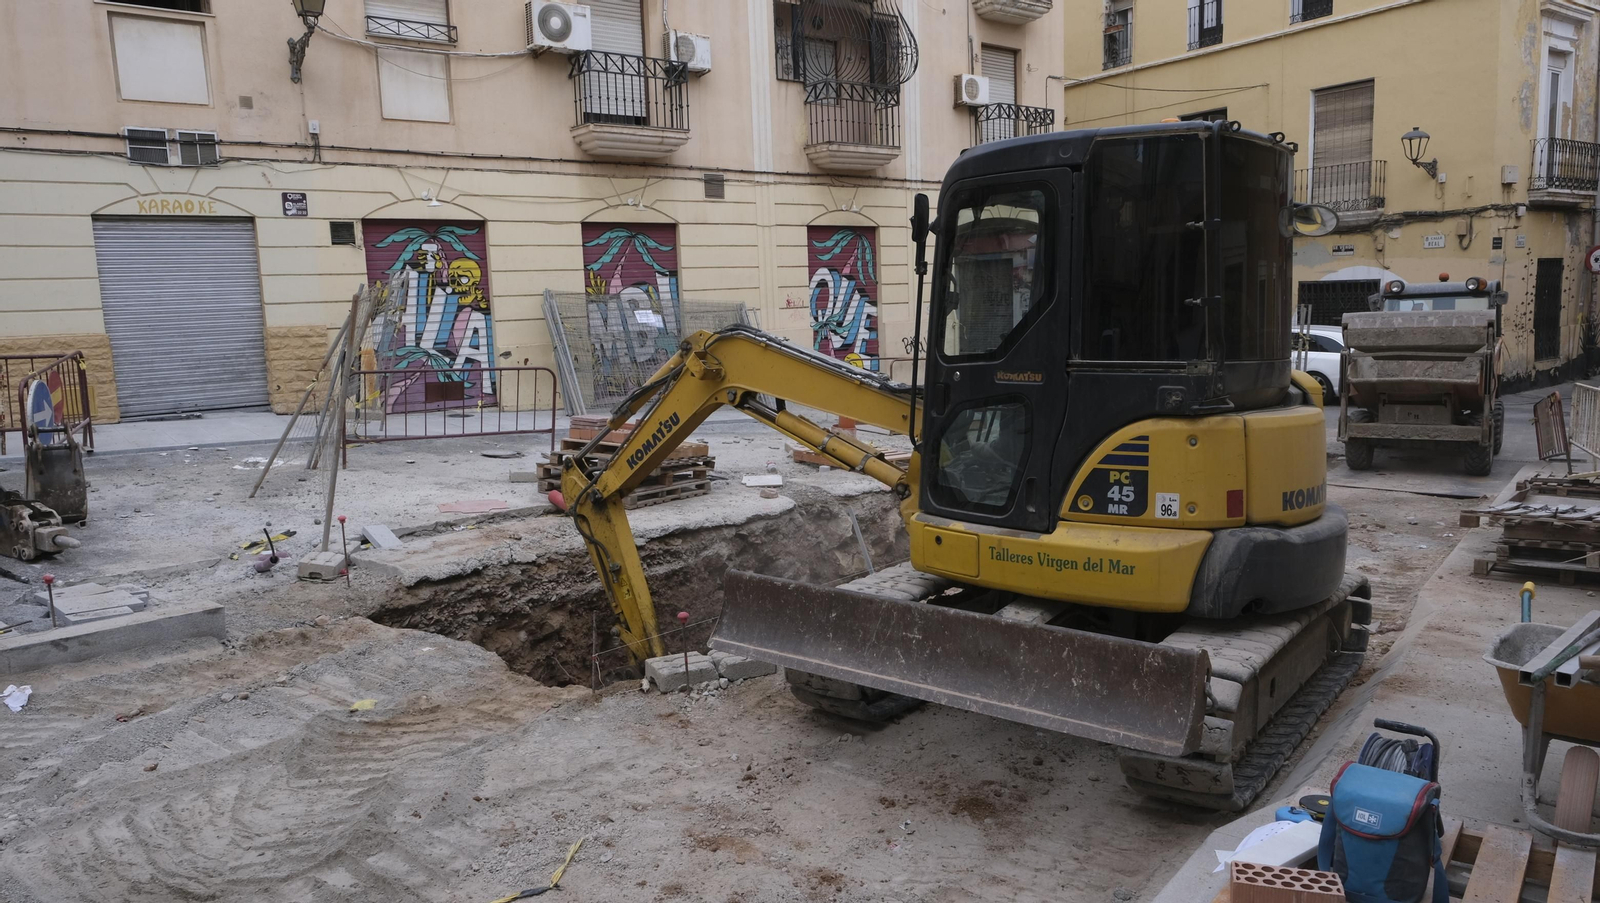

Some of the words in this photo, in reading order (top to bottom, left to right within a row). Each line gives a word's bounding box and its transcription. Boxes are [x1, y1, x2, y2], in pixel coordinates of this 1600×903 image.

[137, 199, 217, 214] KARAOKE
[996, 371, 1043, 382] KOMATSU
[626, 411, 681, 470] KOMATSU
[1109, 470, 1130, 484] PC
[1107, 485, 1135, 502] 45
[1107, 503, 1128, 515] MR
[989, 546, 1034, 565] Talleres
[1037, 552, 1079, 572] Virgen
[1082, 557, 1103, 573] del
[1108, 559, 1136, 575] Mar
